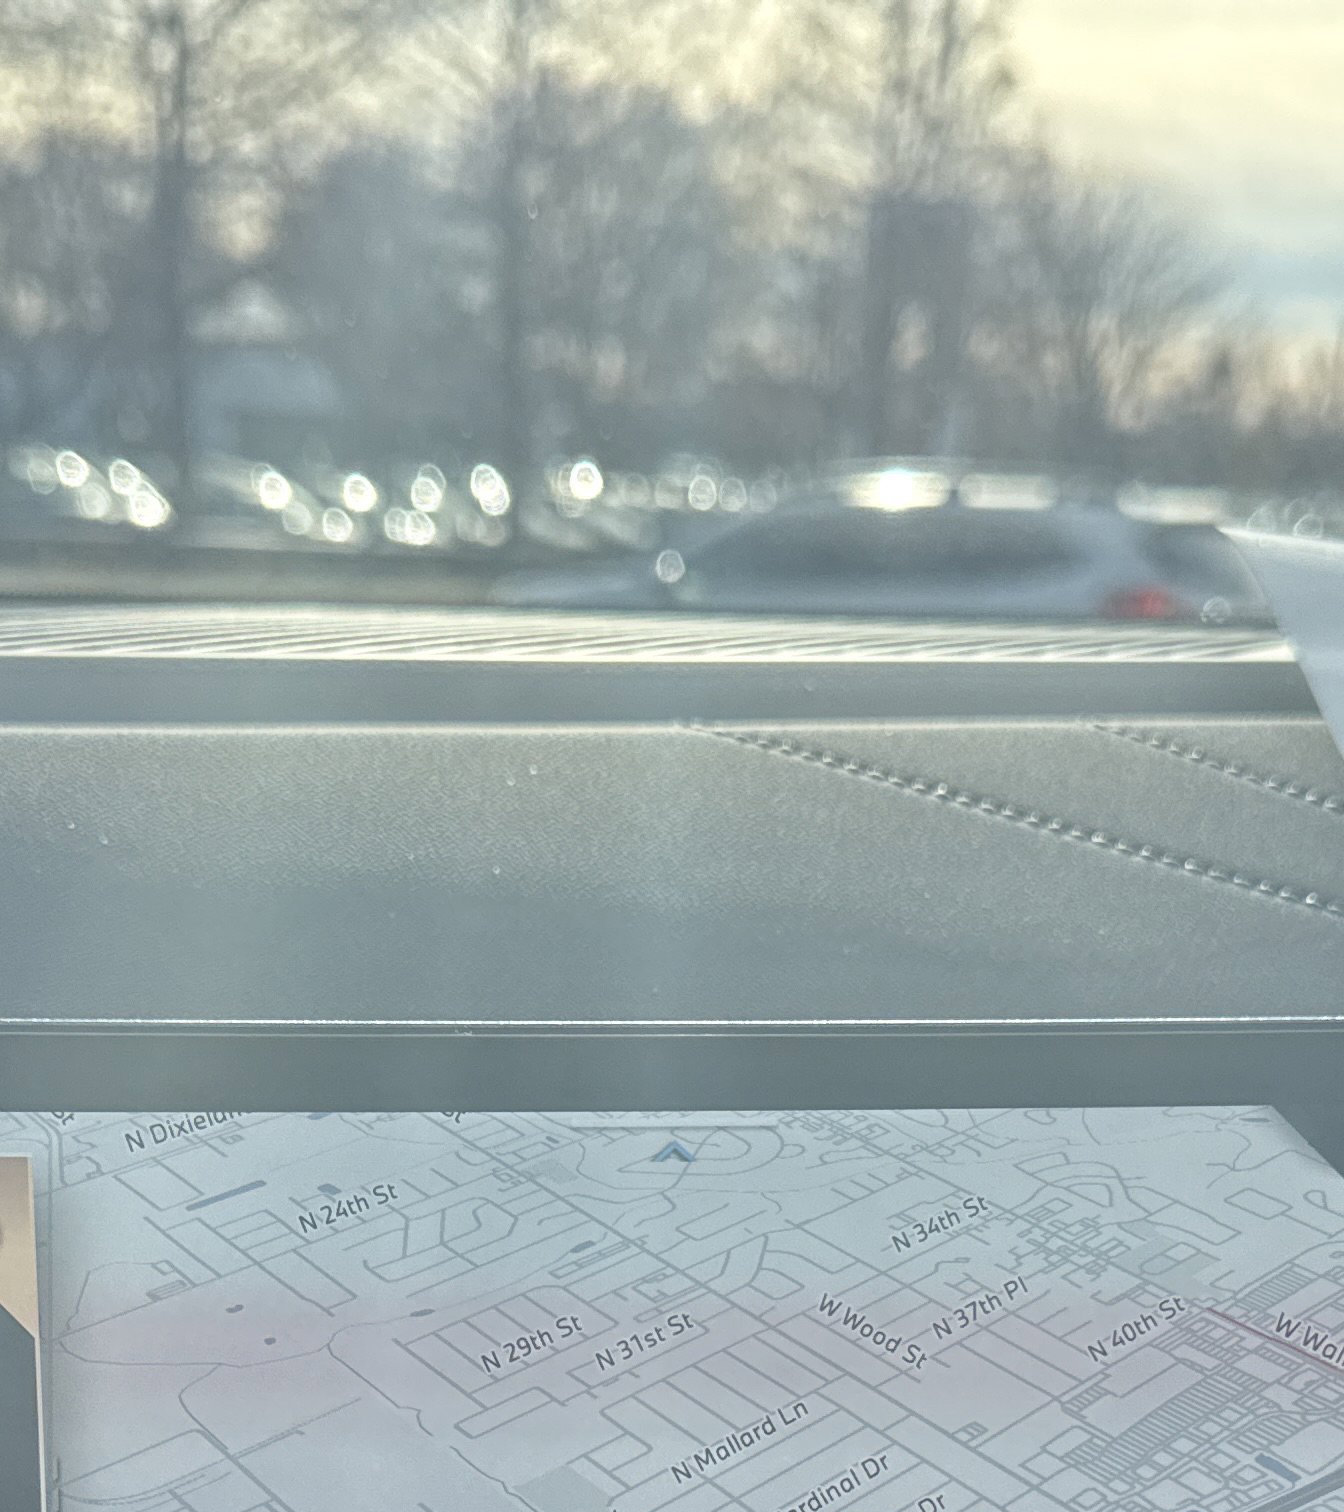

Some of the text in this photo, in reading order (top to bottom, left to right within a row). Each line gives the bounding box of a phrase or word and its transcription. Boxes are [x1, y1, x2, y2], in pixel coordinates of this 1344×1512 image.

[124, 1129, 148, 1153] N
[298, 1184, 400, 1235] N 24th St
[891, 1194, 990, 1255] N 34th St
[817, 1292, 930, 1371] W Wood St
[931, 1275, 1029, 1342] N 37th Pl
[1086, 1296, 1187, 1364] N 40th St
[1273, 1310, 1301, 1339] W
[480, 1314, 585, 1375] N 29th St
[594, 1311, 696, 1372] N 31st St
[670, 1400, 810, 1485] N Mallard Ln
[861, 1452, 891, 1480] Dr
